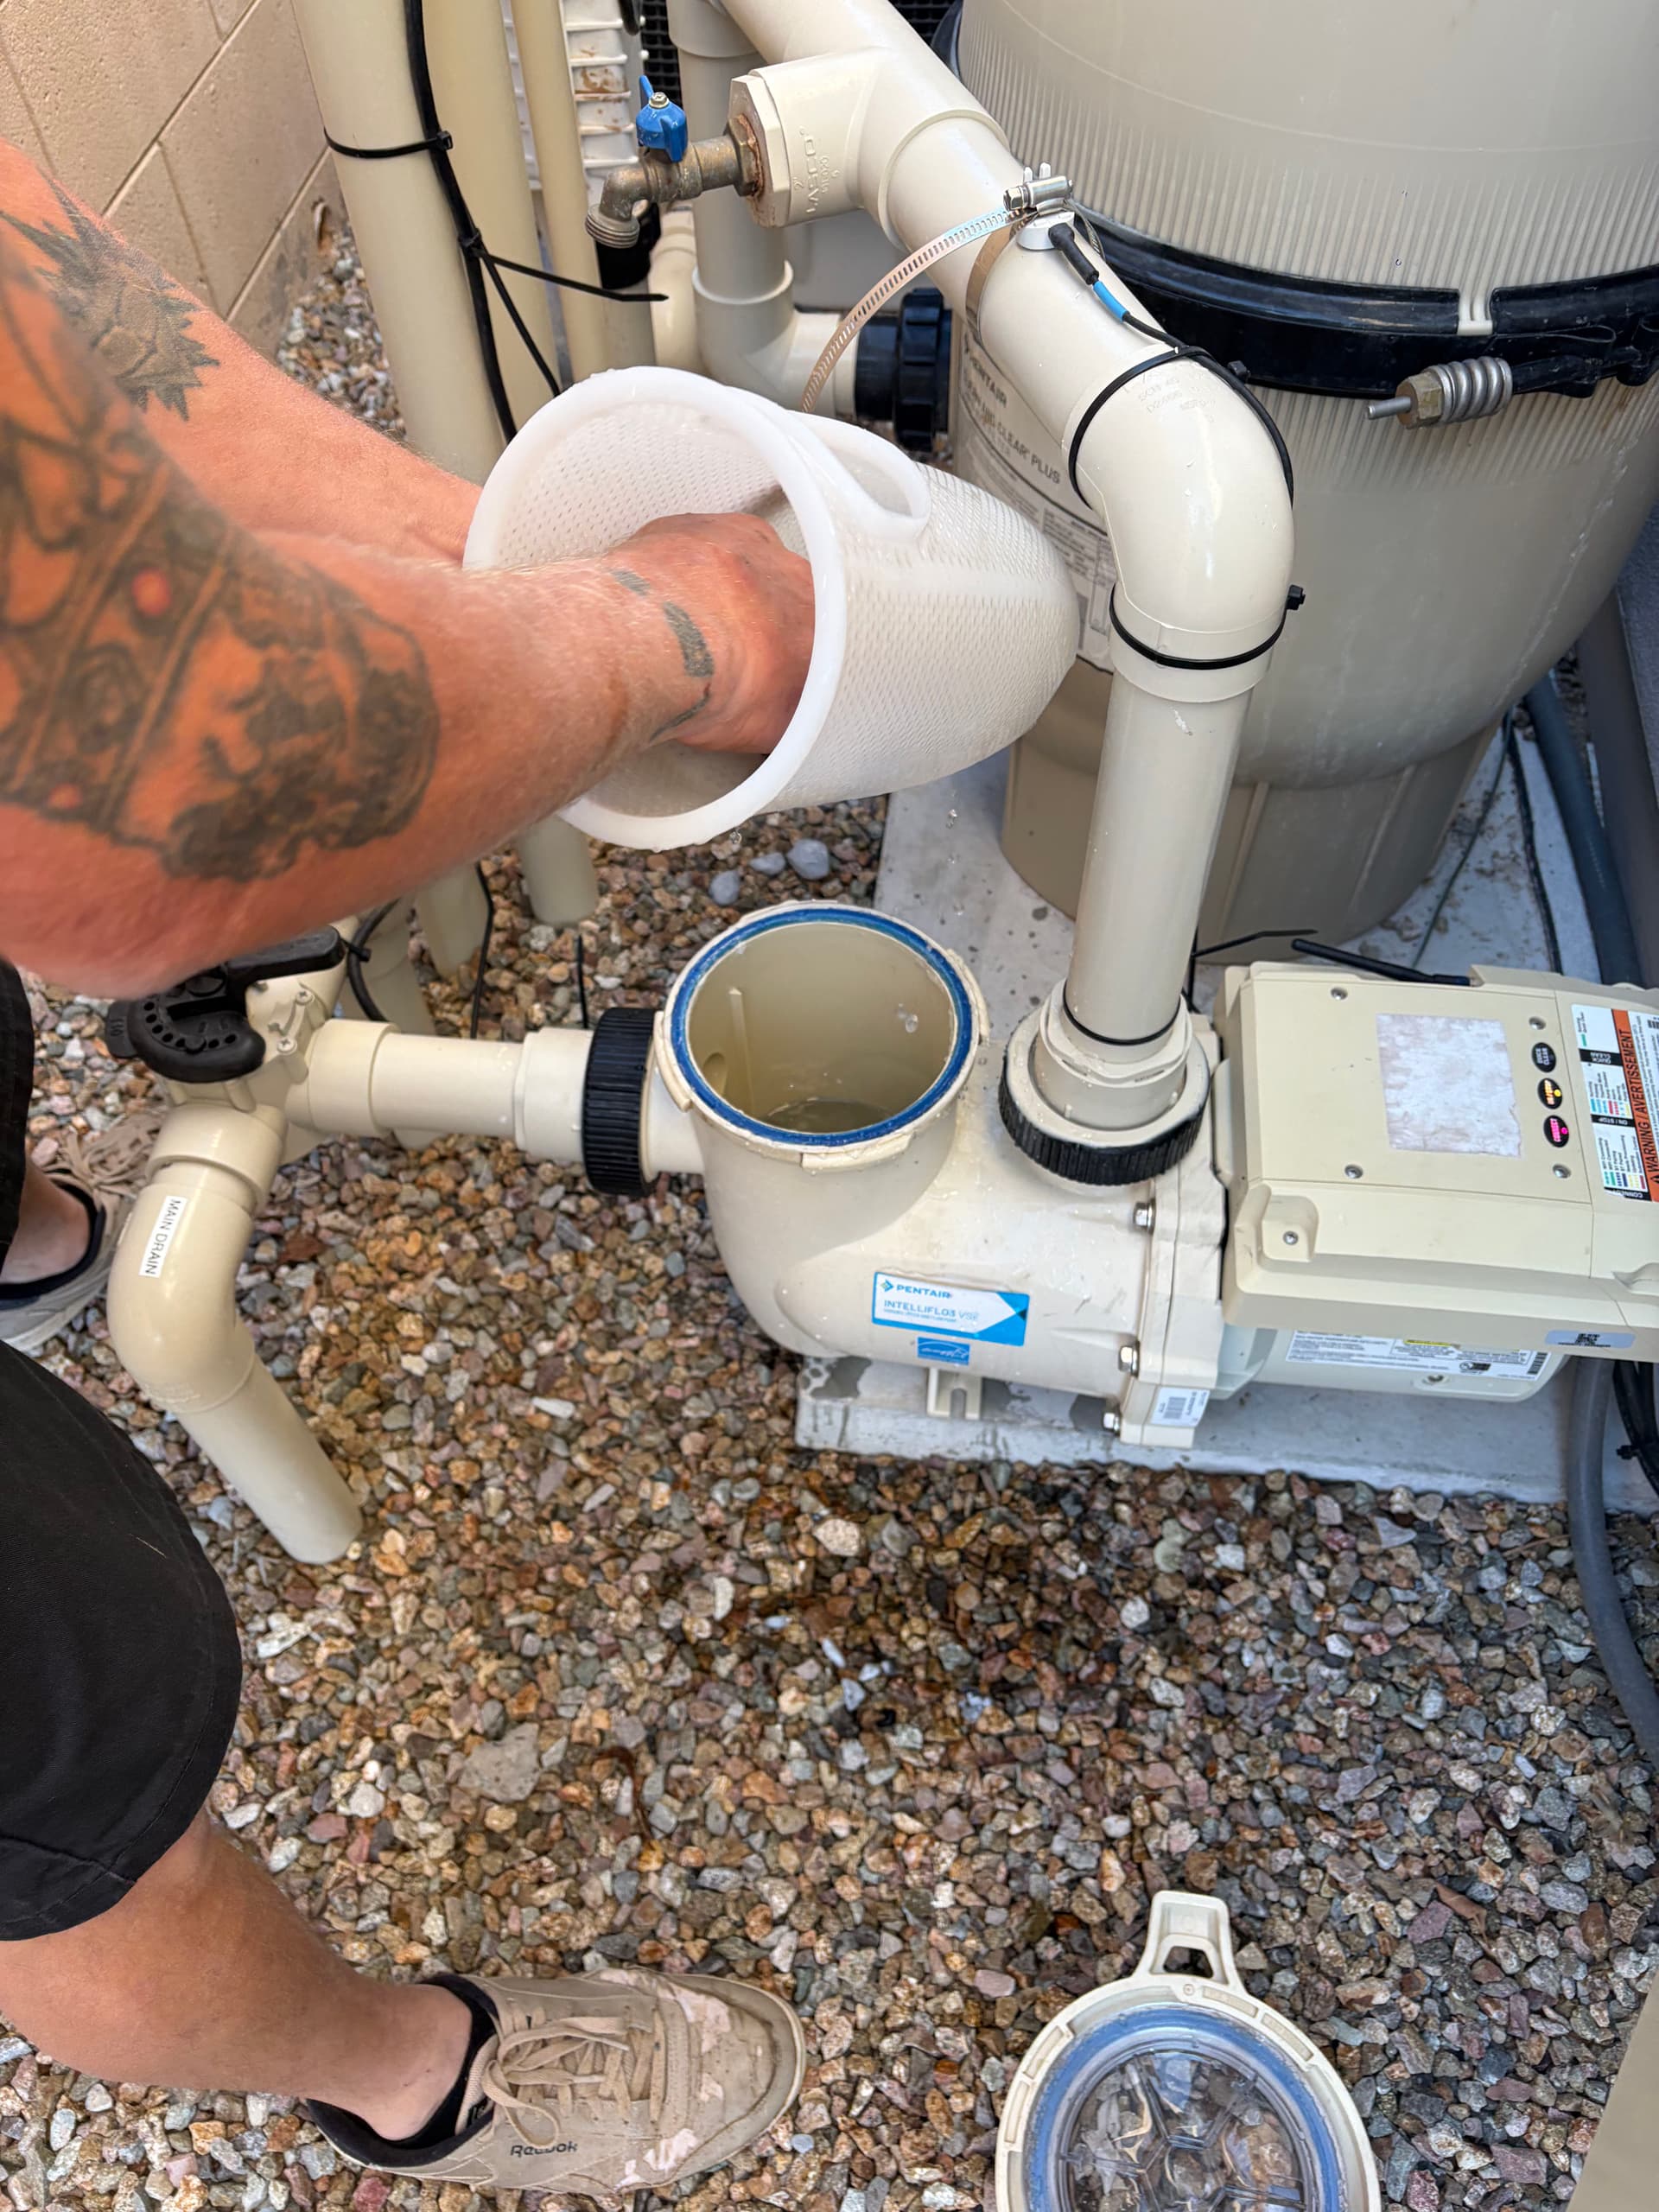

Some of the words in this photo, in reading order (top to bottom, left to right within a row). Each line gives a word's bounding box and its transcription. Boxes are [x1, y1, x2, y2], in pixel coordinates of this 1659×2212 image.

[1031, 453, 1061, 485] PLUS
[1618, 1028, 1648, 1114] AVERTISSEMENT
[1638, 1122, 1659, 1173] WARNING
[160, 1198, 181, 1230] MAIN
[144, 1233, 168, 1275] DRAIN
[896, 1284, 951, 1299] PENTAIR
